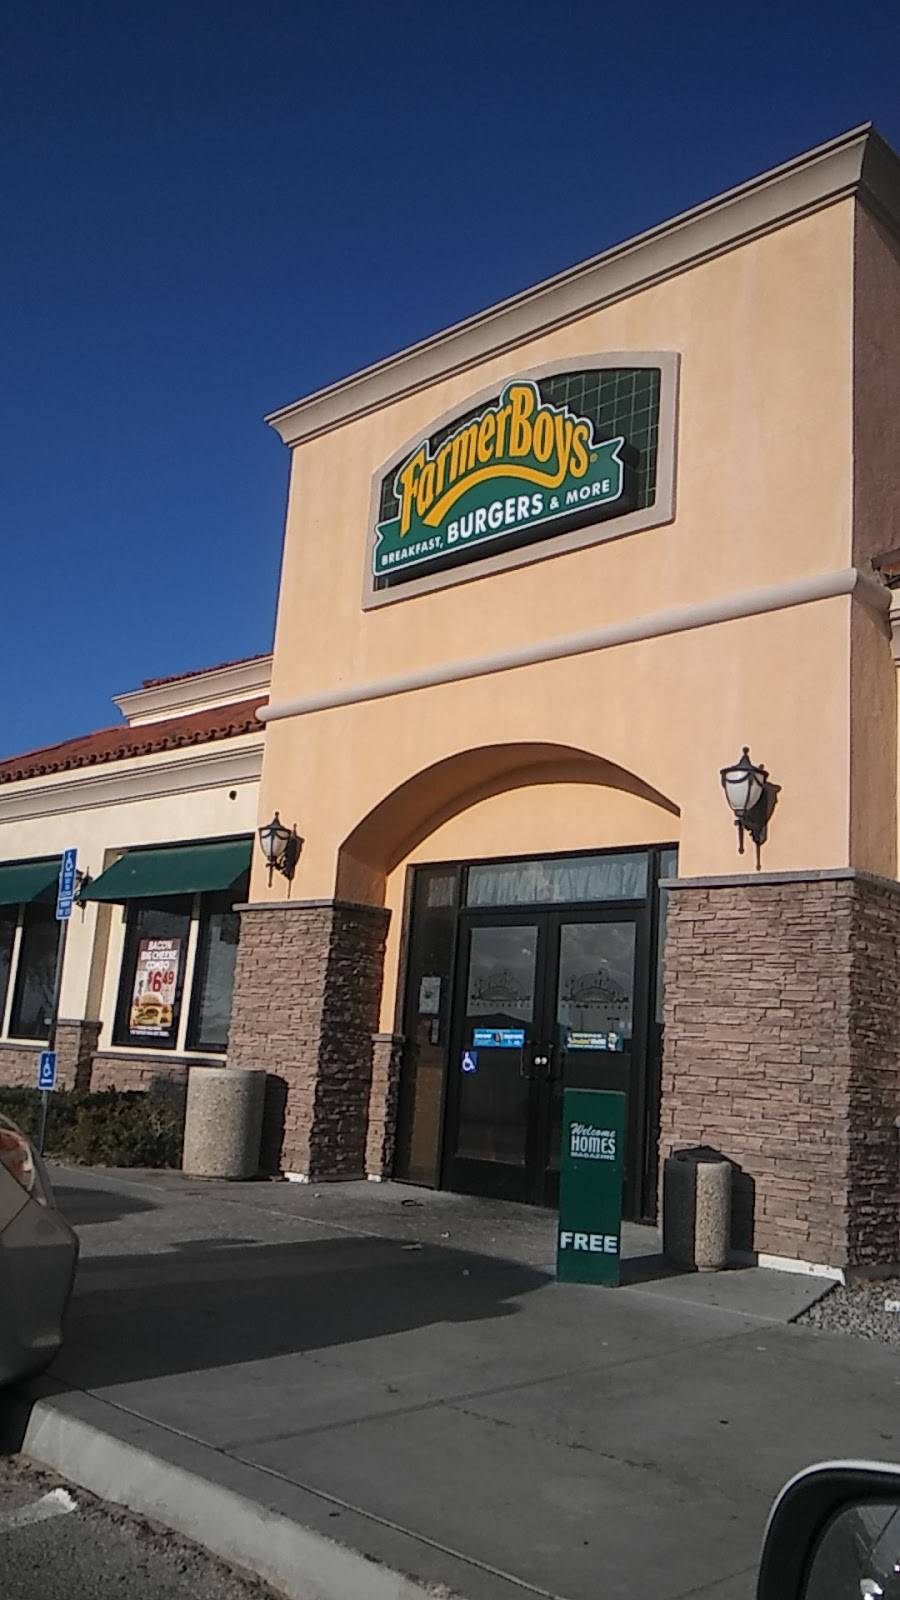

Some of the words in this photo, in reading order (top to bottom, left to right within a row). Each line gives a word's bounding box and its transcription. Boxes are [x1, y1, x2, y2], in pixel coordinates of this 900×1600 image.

[380, 535, 444, 567] BREAKFAST,
[446, 492, 544, 545] BURGERS
[549, 497, 561, 510] &
[565, 478, 611, 506] MORE
[570, 1122, 617, 1138] Welcome
[570, 1135, 616, 1155] HOMES
[570, 1151, 616, 1161] MAGAZINE
[559, 1231, 618, 1254] FREE
